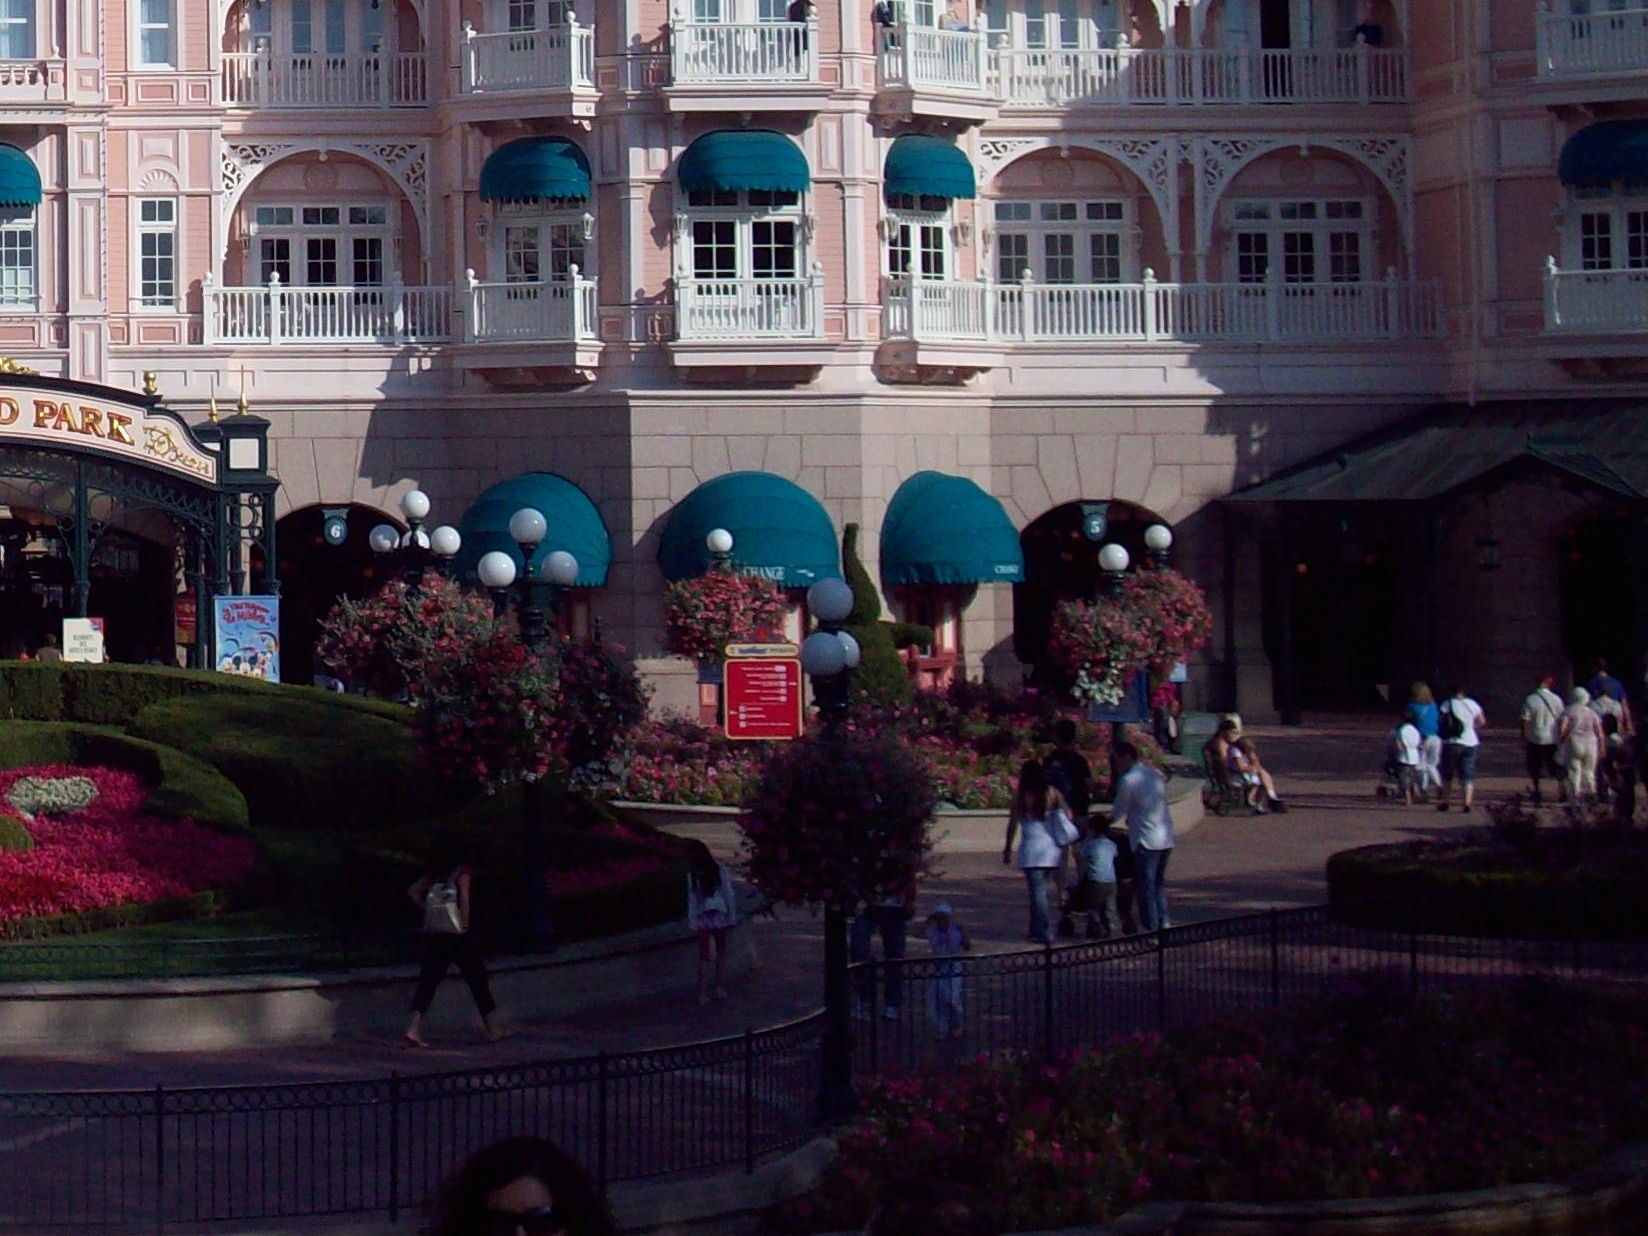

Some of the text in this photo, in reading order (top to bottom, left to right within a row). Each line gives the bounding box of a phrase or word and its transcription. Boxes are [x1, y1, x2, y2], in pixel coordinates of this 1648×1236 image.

[33, 398, 136, 446] PARK
[330, 524, 341, 539] 6
[743, 565, 786, 580] CHANGE
